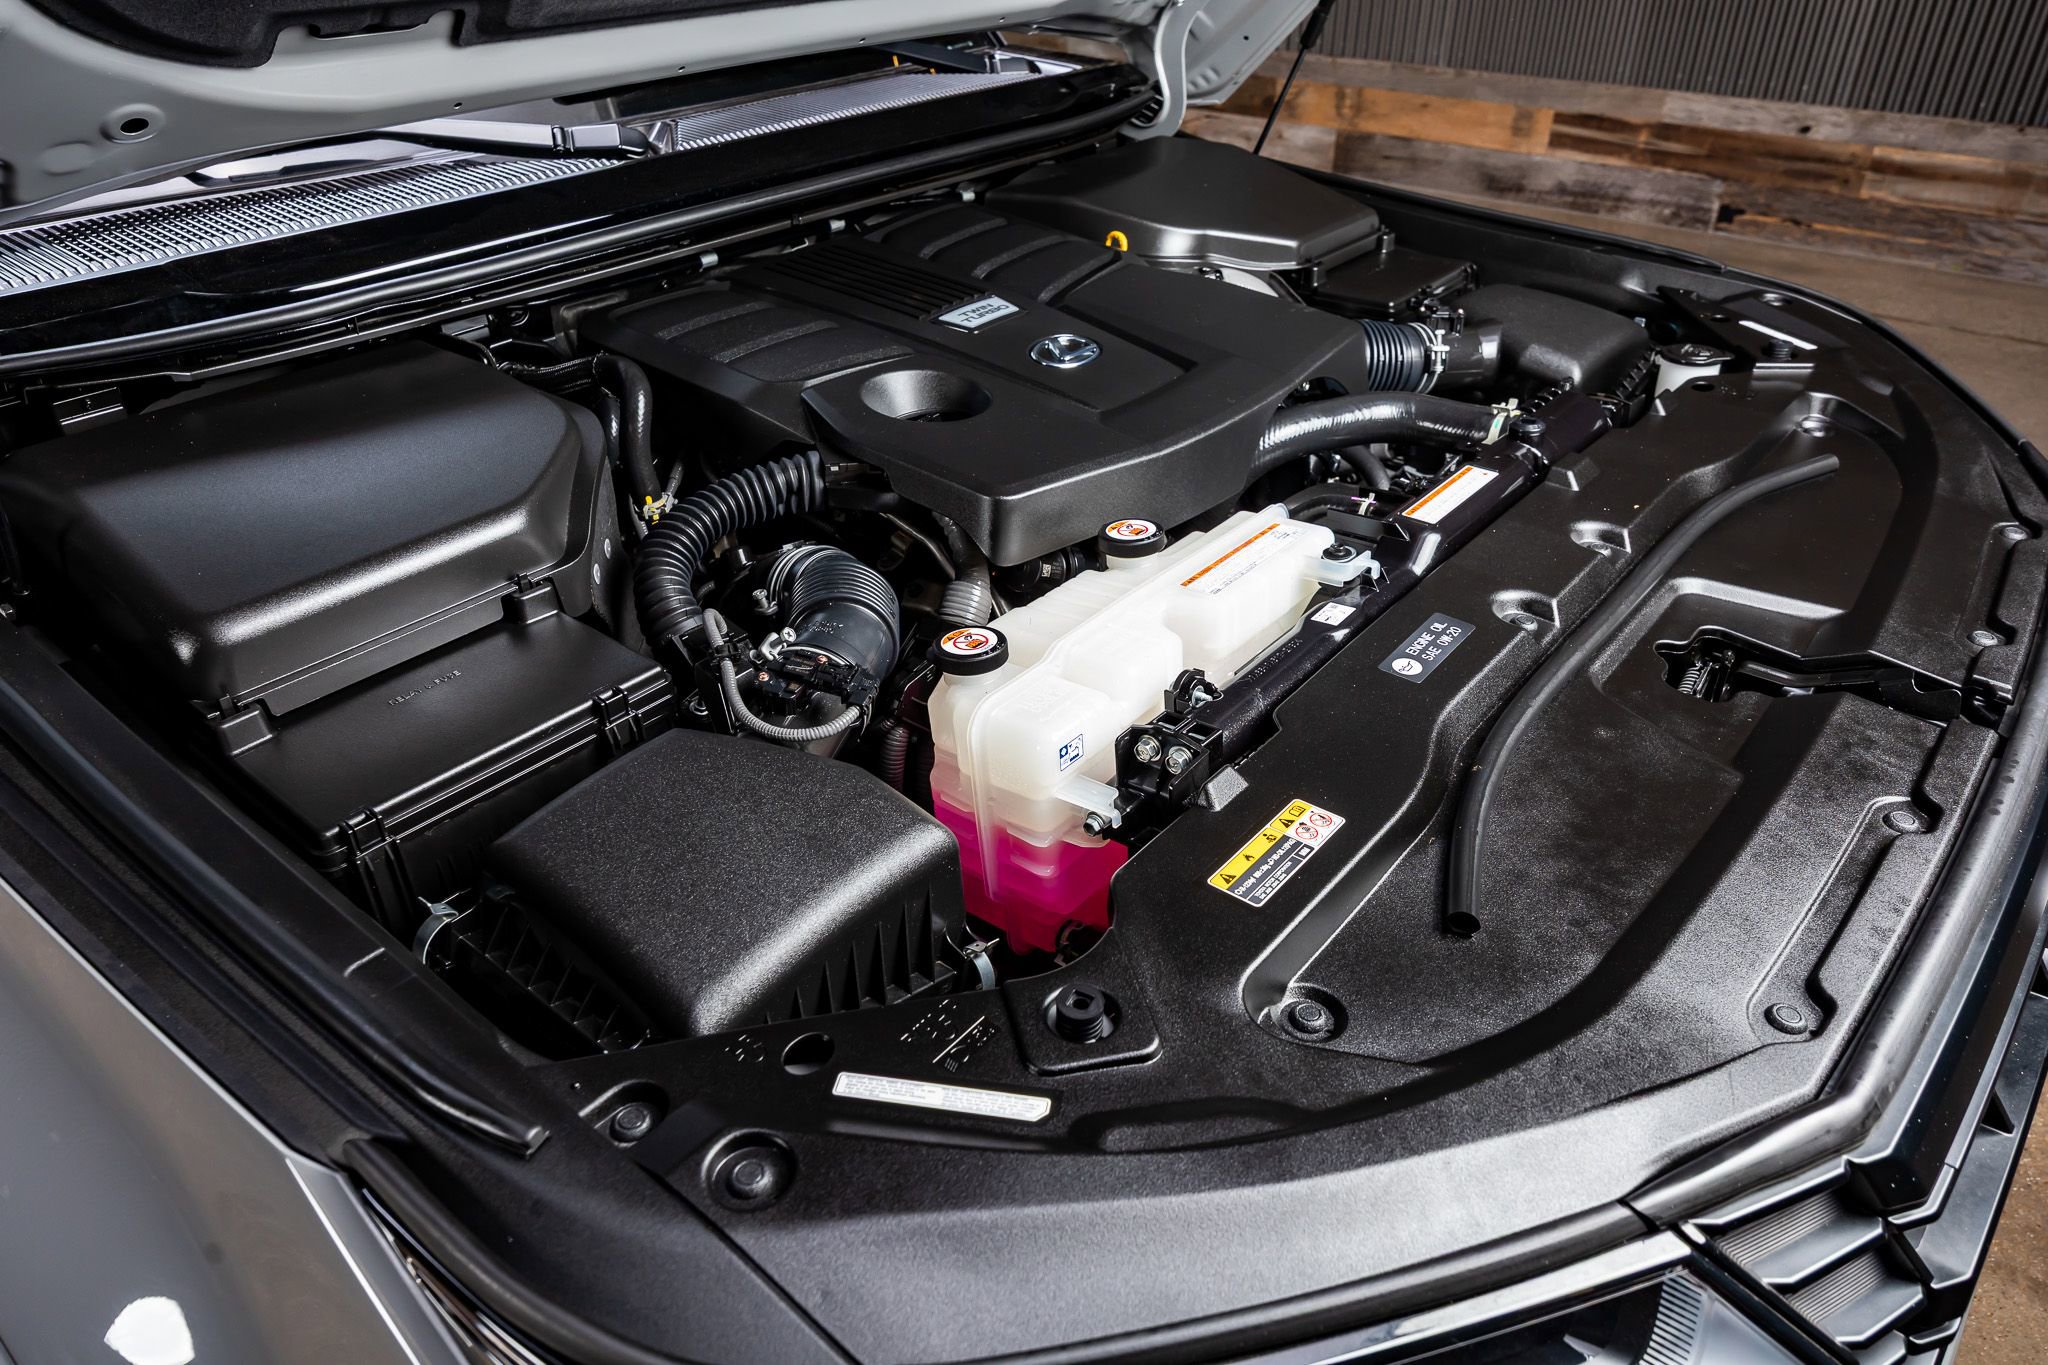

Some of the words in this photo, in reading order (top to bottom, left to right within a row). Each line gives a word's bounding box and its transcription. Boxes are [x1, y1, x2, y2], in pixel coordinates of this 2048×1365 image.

[958, 303, 993, 317] TWIN
[961, 304, 1010, 323] TURBO
[1405, 631, 1436, 656] ENGINE
[1421, 645, 1442, 661] SAE
[387, 688, 423, 706] RELAY
[433, 670, 462, 685] FUSE
